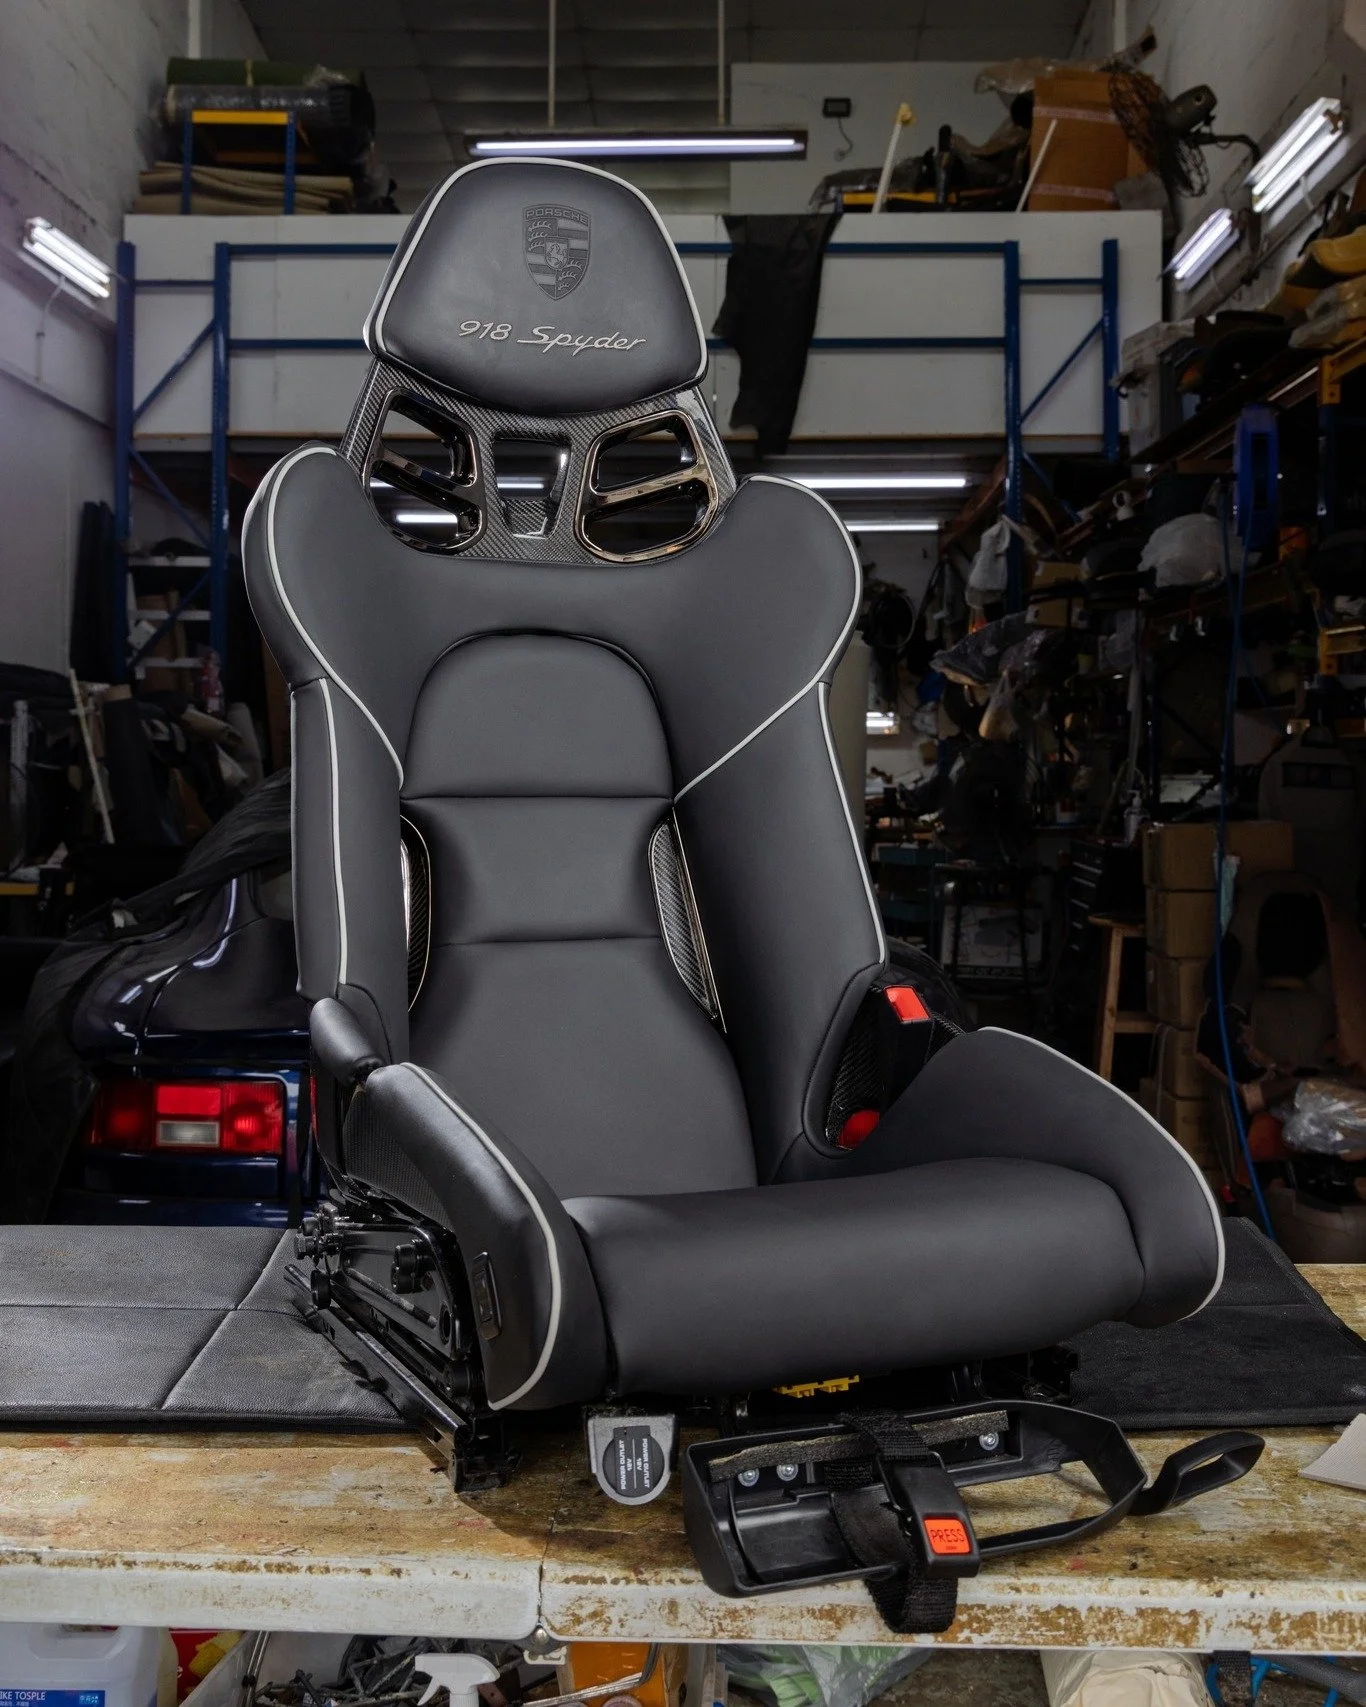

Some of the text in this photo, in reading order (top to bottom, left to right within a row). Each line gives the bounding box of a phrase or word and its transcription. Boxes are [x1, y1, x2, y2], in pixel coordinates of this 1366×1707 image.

[526, 207, 589, 224] PORSCHE
[458, 320, 647, 356] 918 Spyder
[930, 1529, 965, 1543] PRESS
[15, 1691, 46, 1701] TOSPLE
